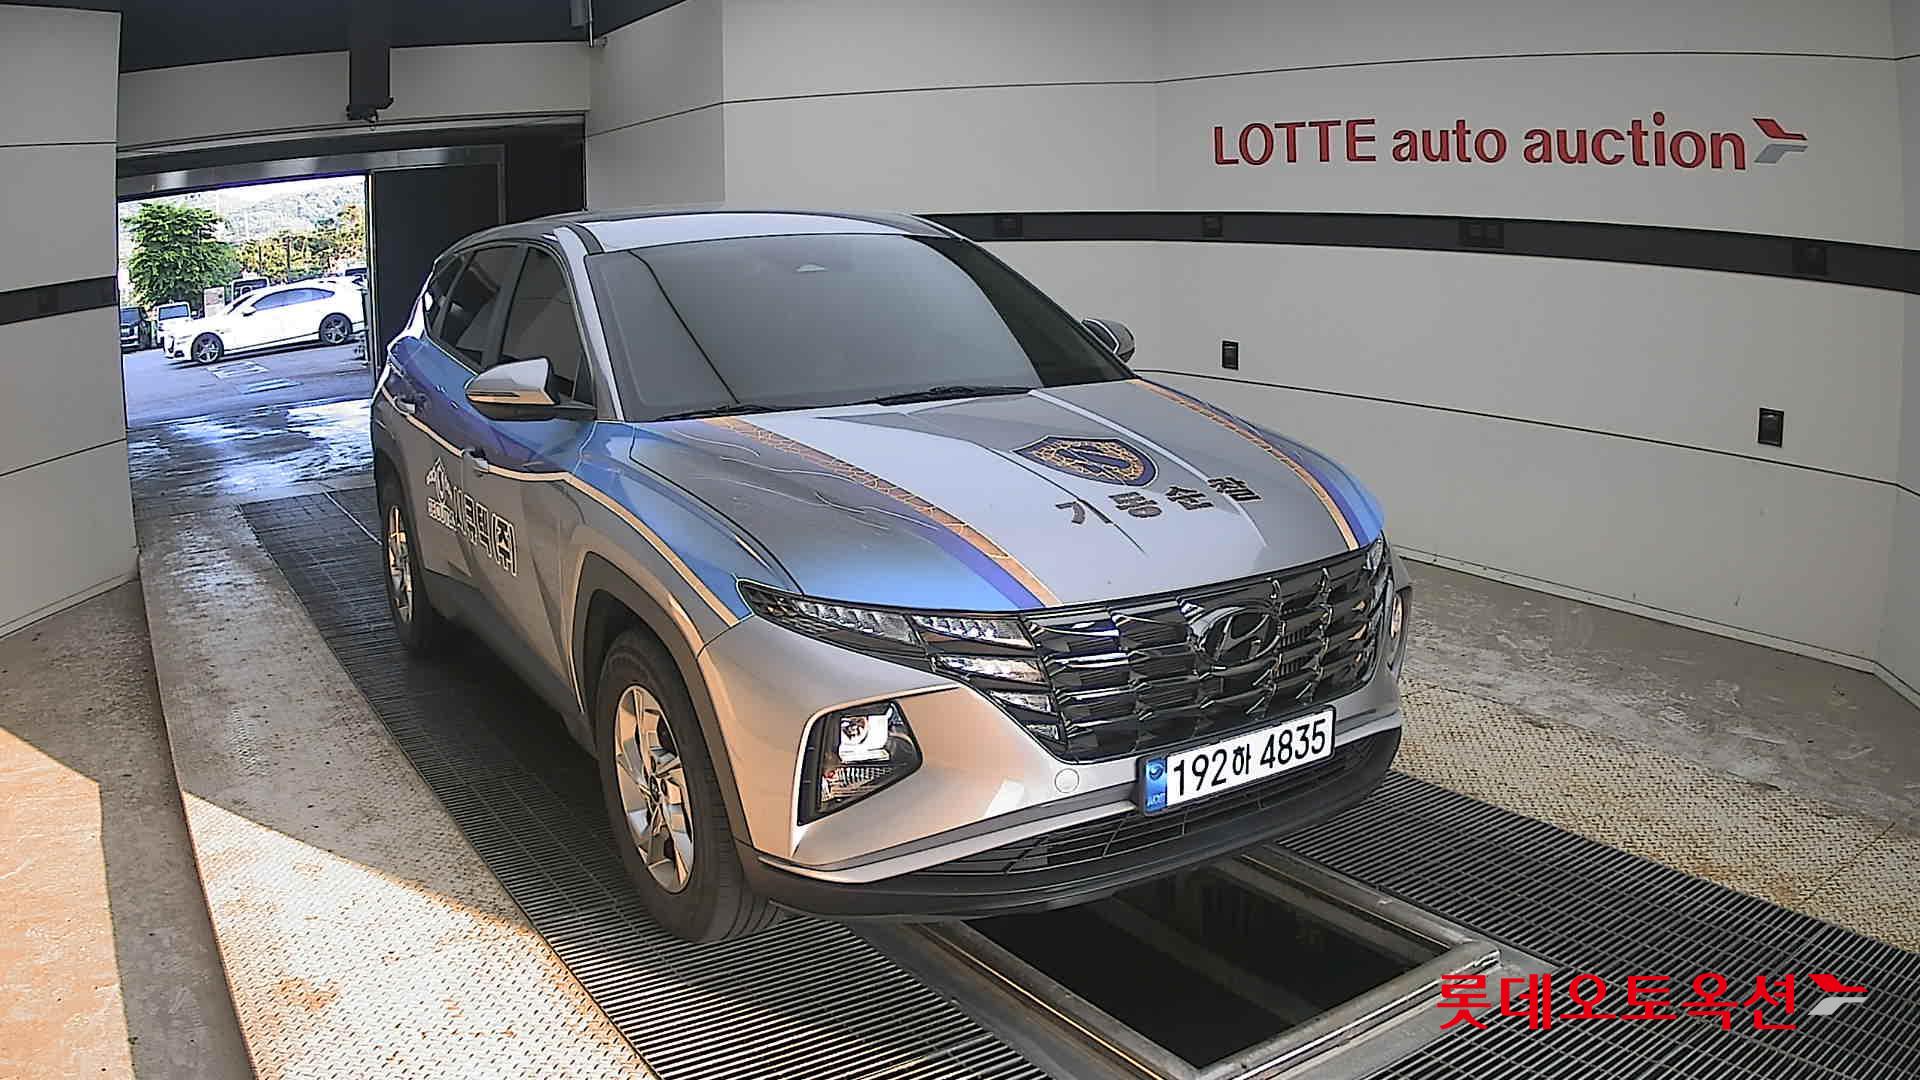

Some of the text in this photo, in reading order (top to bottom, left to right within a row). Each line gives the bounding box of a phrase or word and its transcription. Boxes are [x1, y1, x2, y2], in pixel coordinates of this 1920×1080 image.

[1213, 111, 1746, 171] LOTTE auto auction
[1173, 718, 1326, 796] 192하 4835
